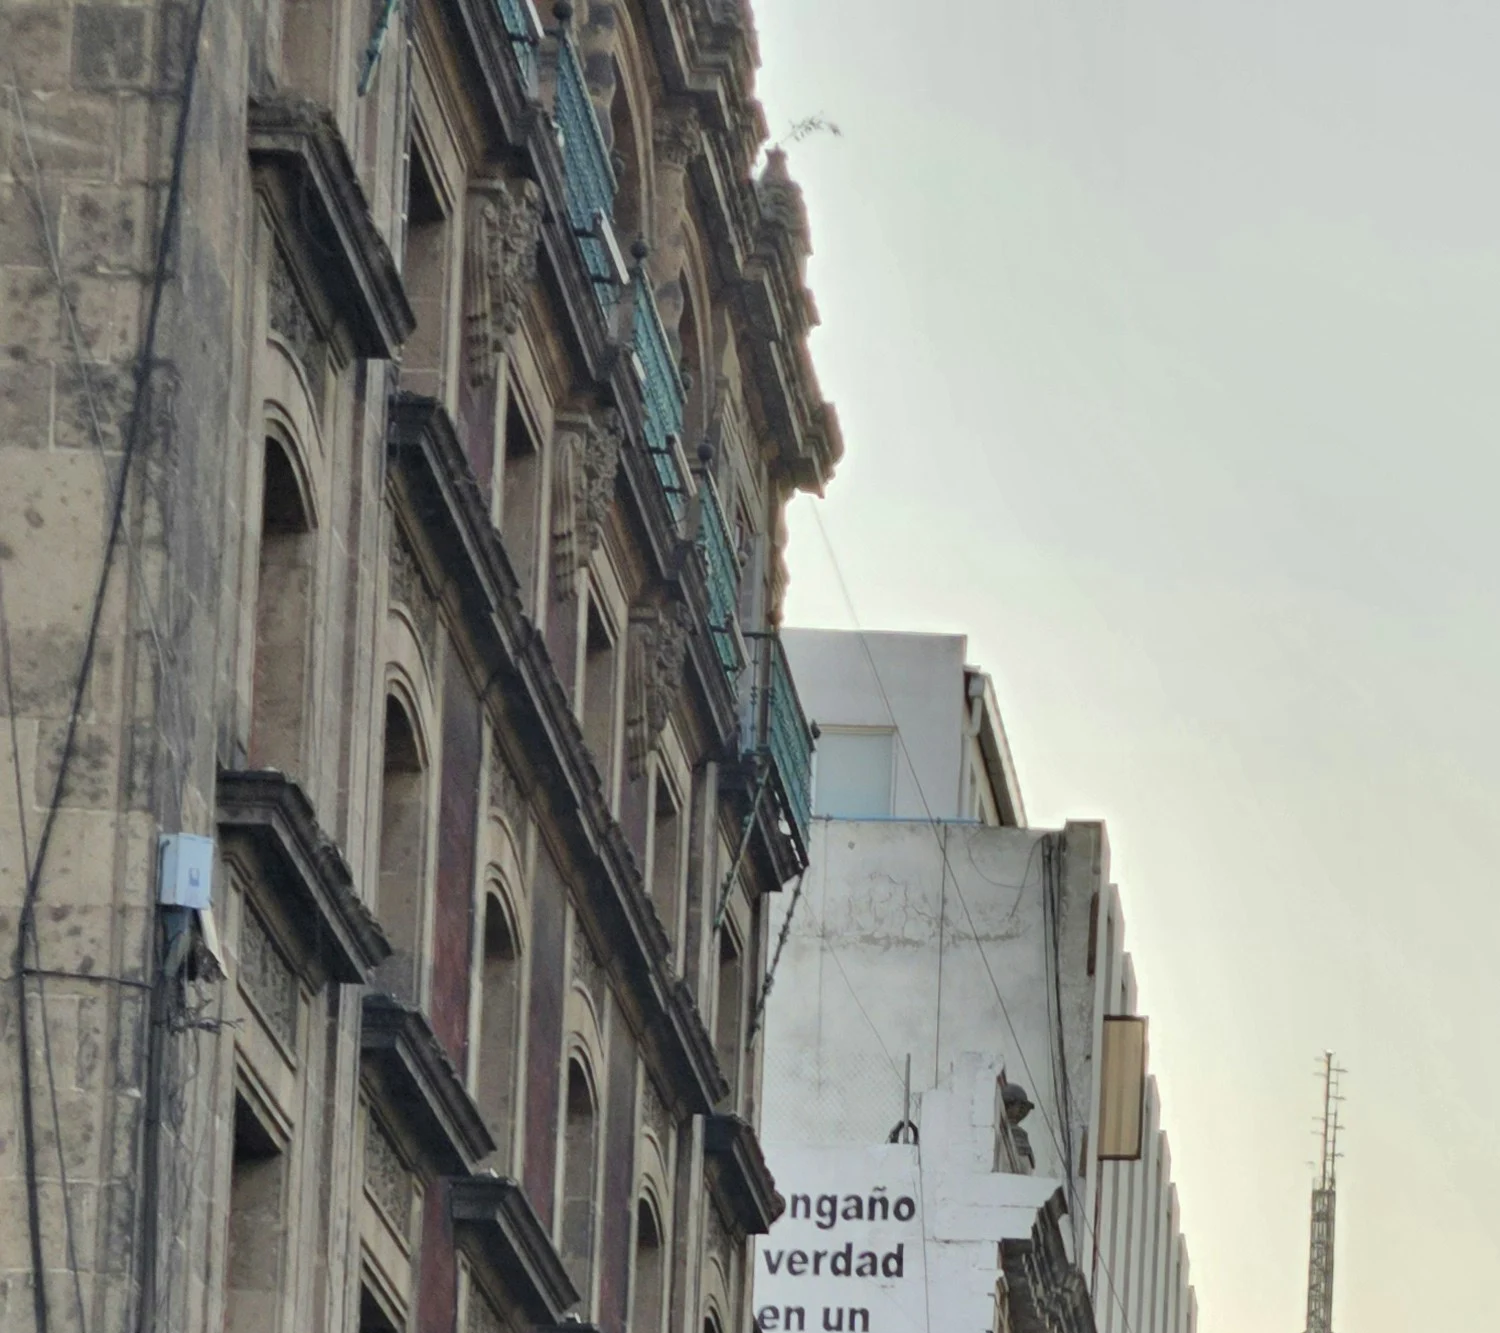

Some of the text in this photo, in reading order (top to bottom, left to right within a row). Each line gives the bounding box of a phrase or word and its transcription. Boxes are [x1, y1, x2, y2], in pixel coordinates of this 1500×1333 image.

[791, 1186, 916, 1230] ngaño
[763, 1243, 904, 1277] verdad
[757, 1304, 870, 1332] en un
